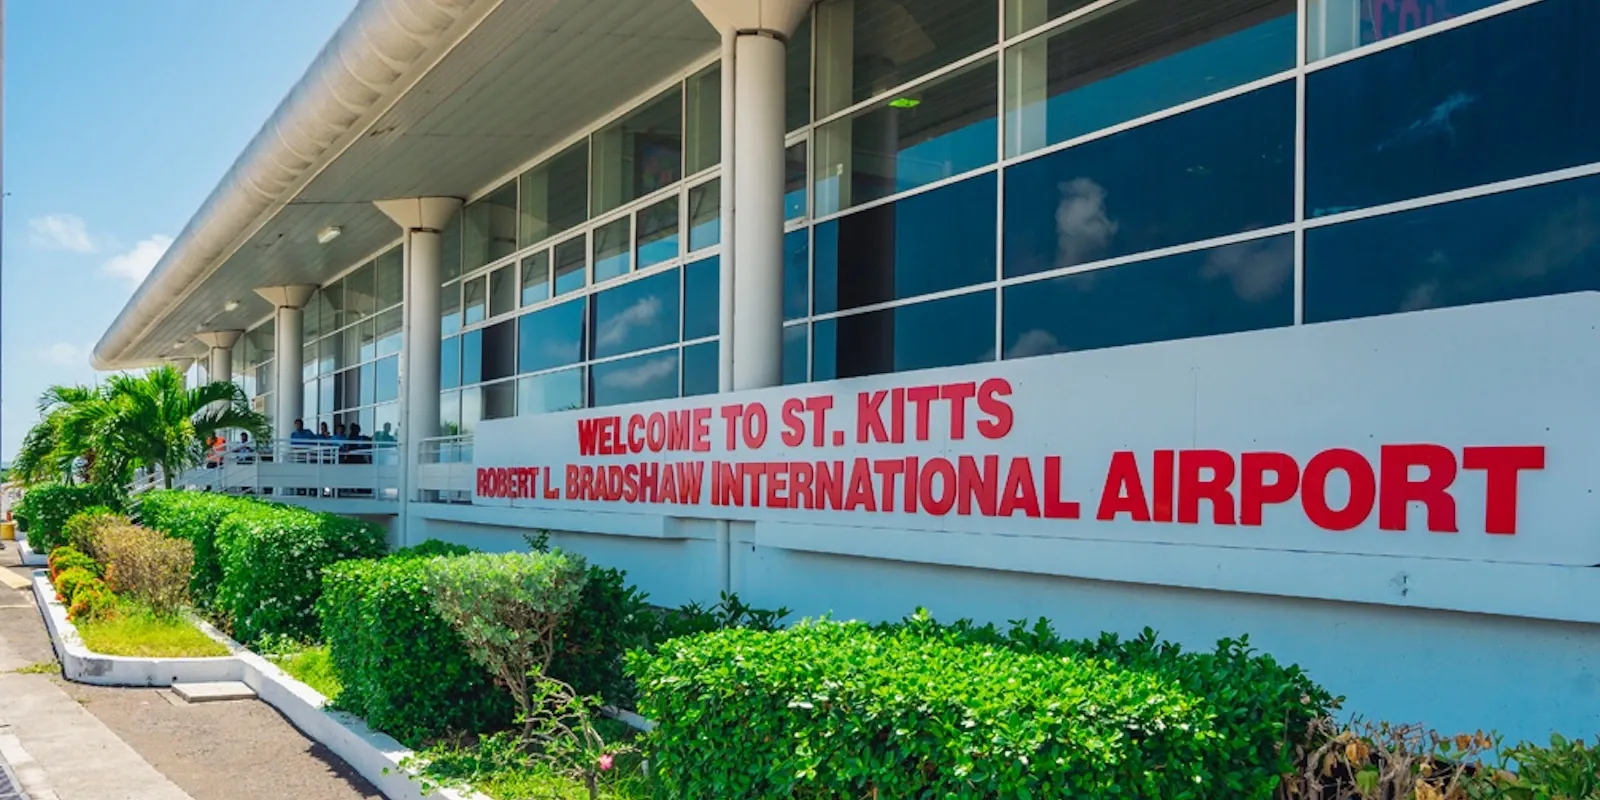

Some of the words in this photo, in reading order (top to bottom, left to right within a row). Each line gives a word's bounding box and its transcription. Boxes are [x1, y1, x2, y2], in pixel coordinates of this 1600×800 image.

[578, 408, 711, 456] WELCOME
[721, 403, 768, 450] TO
[781, 396, 845, 447] ST.
[857, 378, 1014, 444] KITTS
[476, 467, 539, 498] ROBERT
[543, 470, 560, 500] L.
[565, 461, 703, 505] BRADSHAW
[711, 455, 1080, 520] INTERNATIONAL
[1097, 444, 1545, 535] AIRPORT
